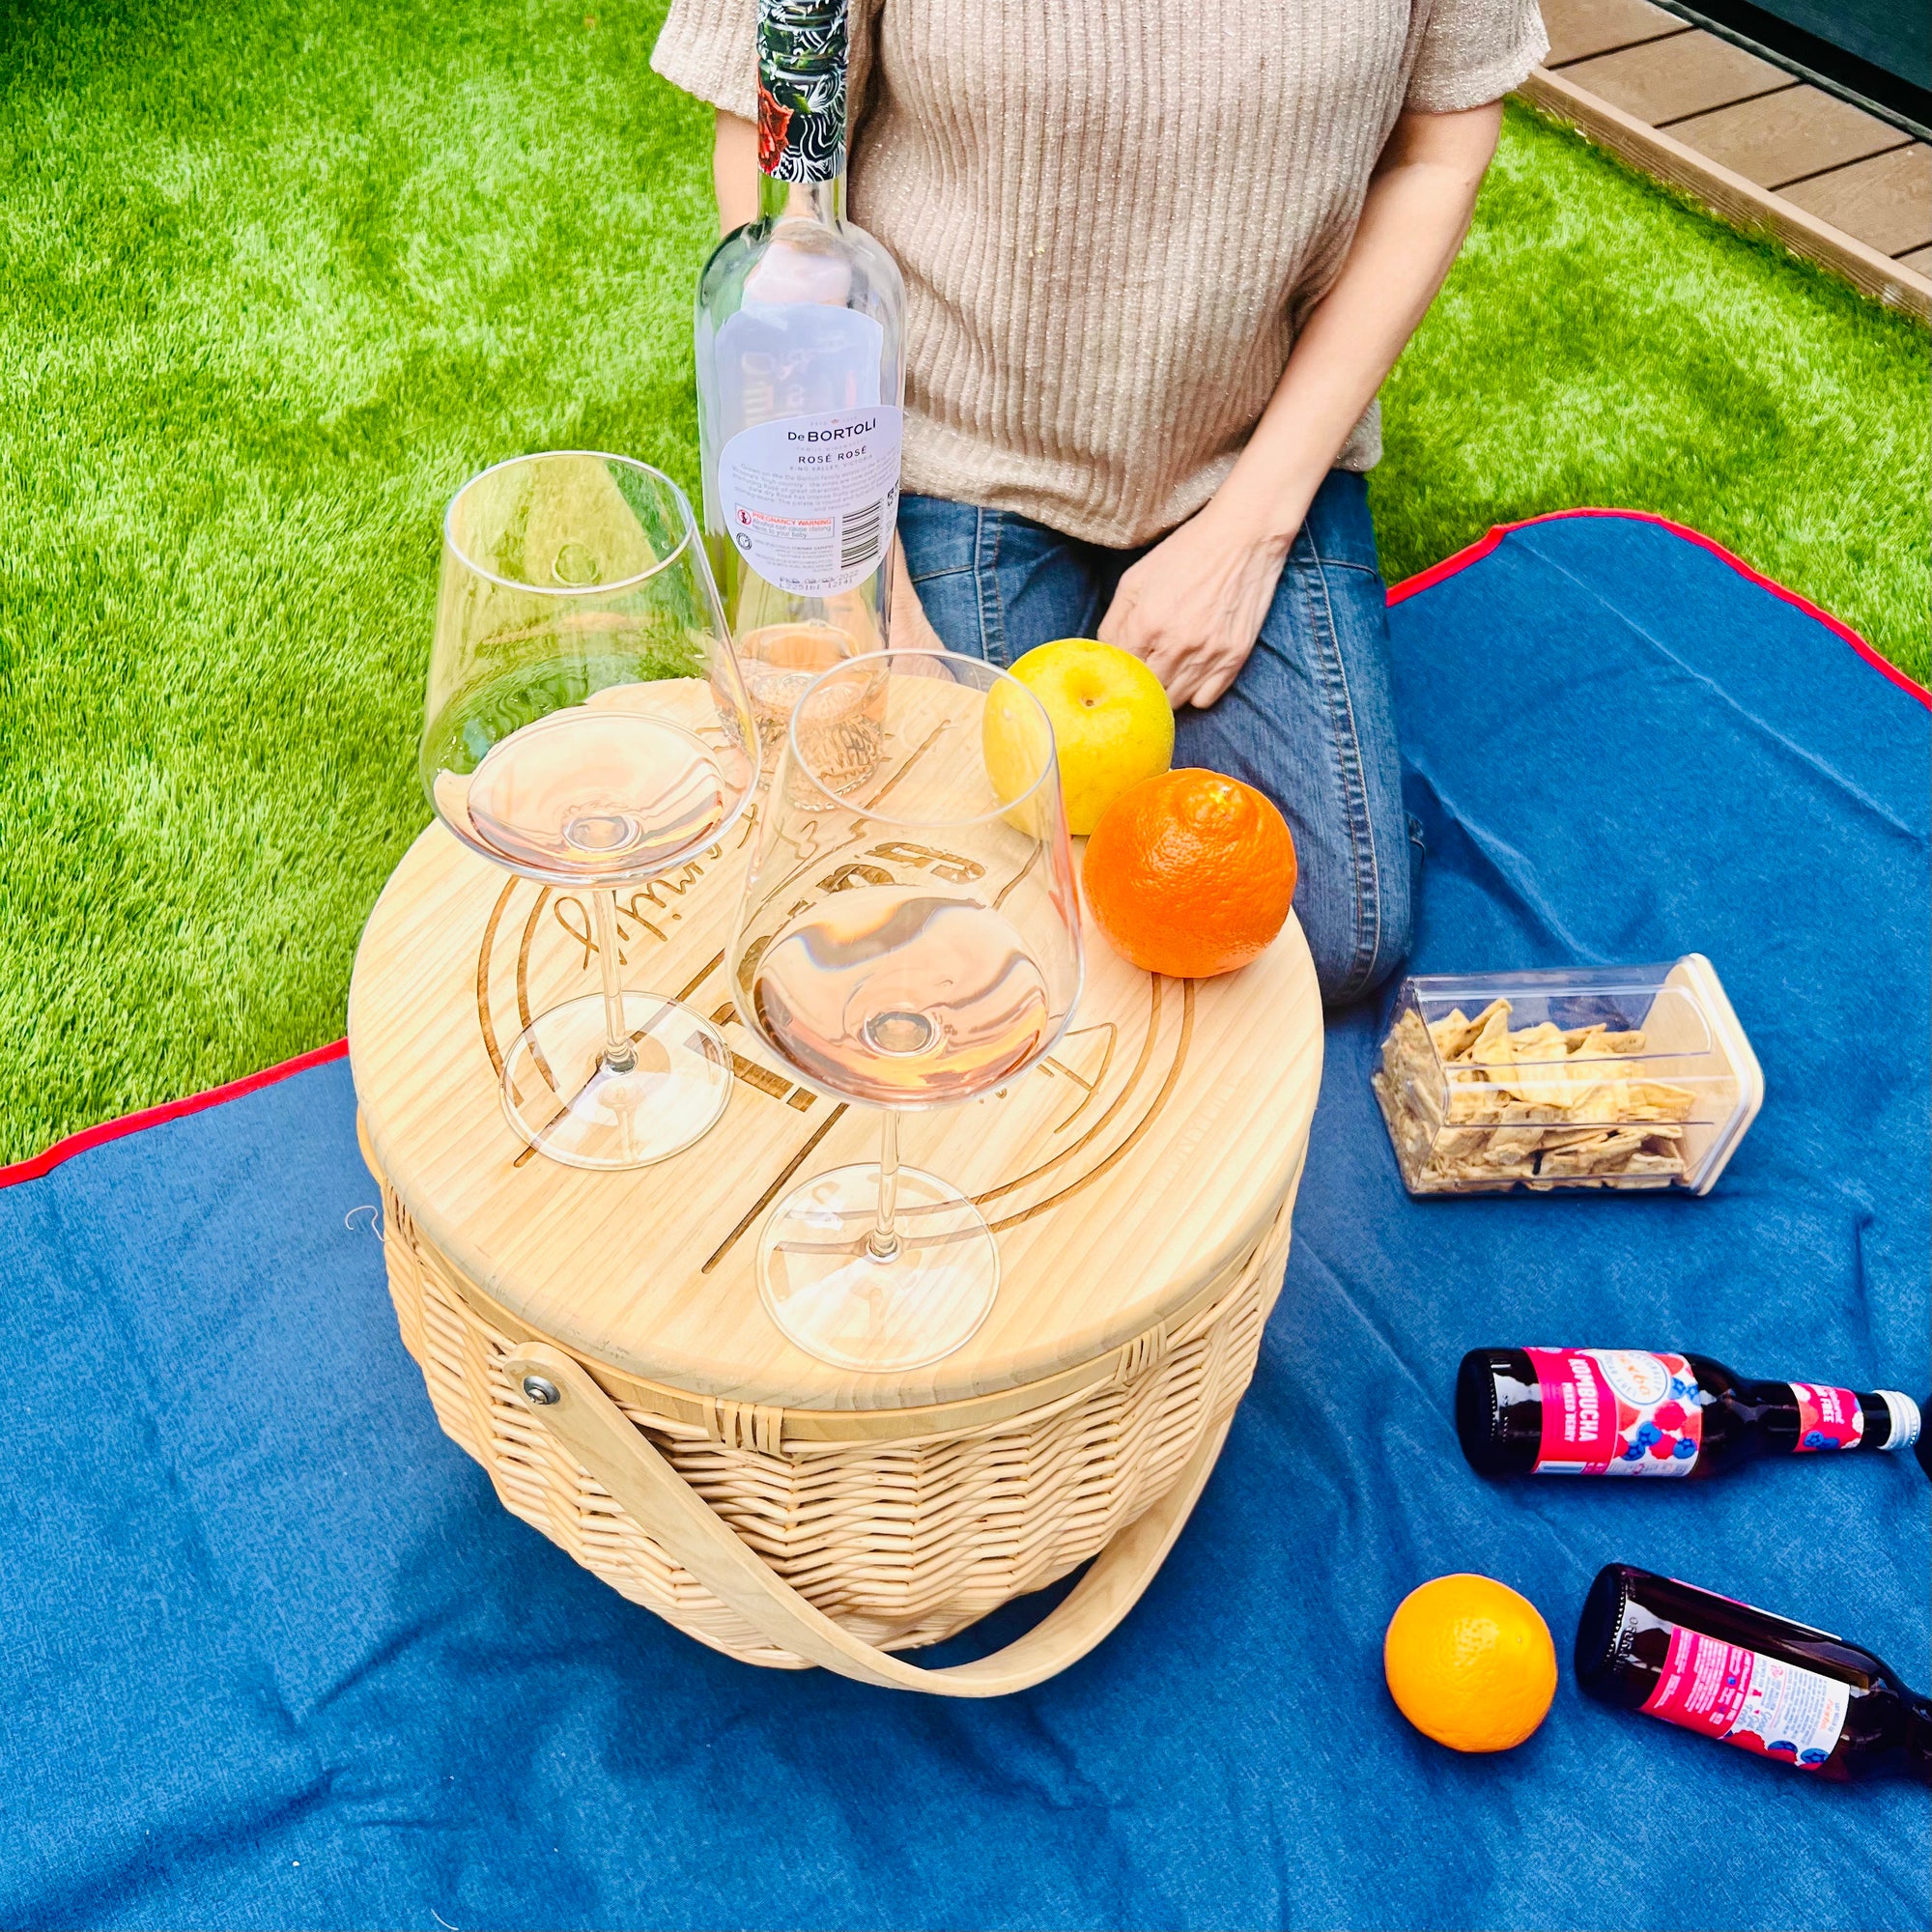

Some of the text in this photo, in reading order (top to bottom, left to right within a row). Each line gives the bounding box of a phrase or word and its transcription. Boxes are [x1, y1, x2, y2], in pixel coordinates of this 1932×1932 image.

[787, 431, 805, 441] De
[808, 417, 876, 442] BORTOLI
[798, 444, 867, 464] ROSÉ ROSÉ
[753, 510, 796, 526] PREGNANCY
[1561, 1382, 1577, 1443] MIXED BERRY
[1567, 1358, 1601, 1442] KOMBUCHA
[1819, 1397, 1835, 1423] FREE
[1755, 1711, 1773, 1733] Good
